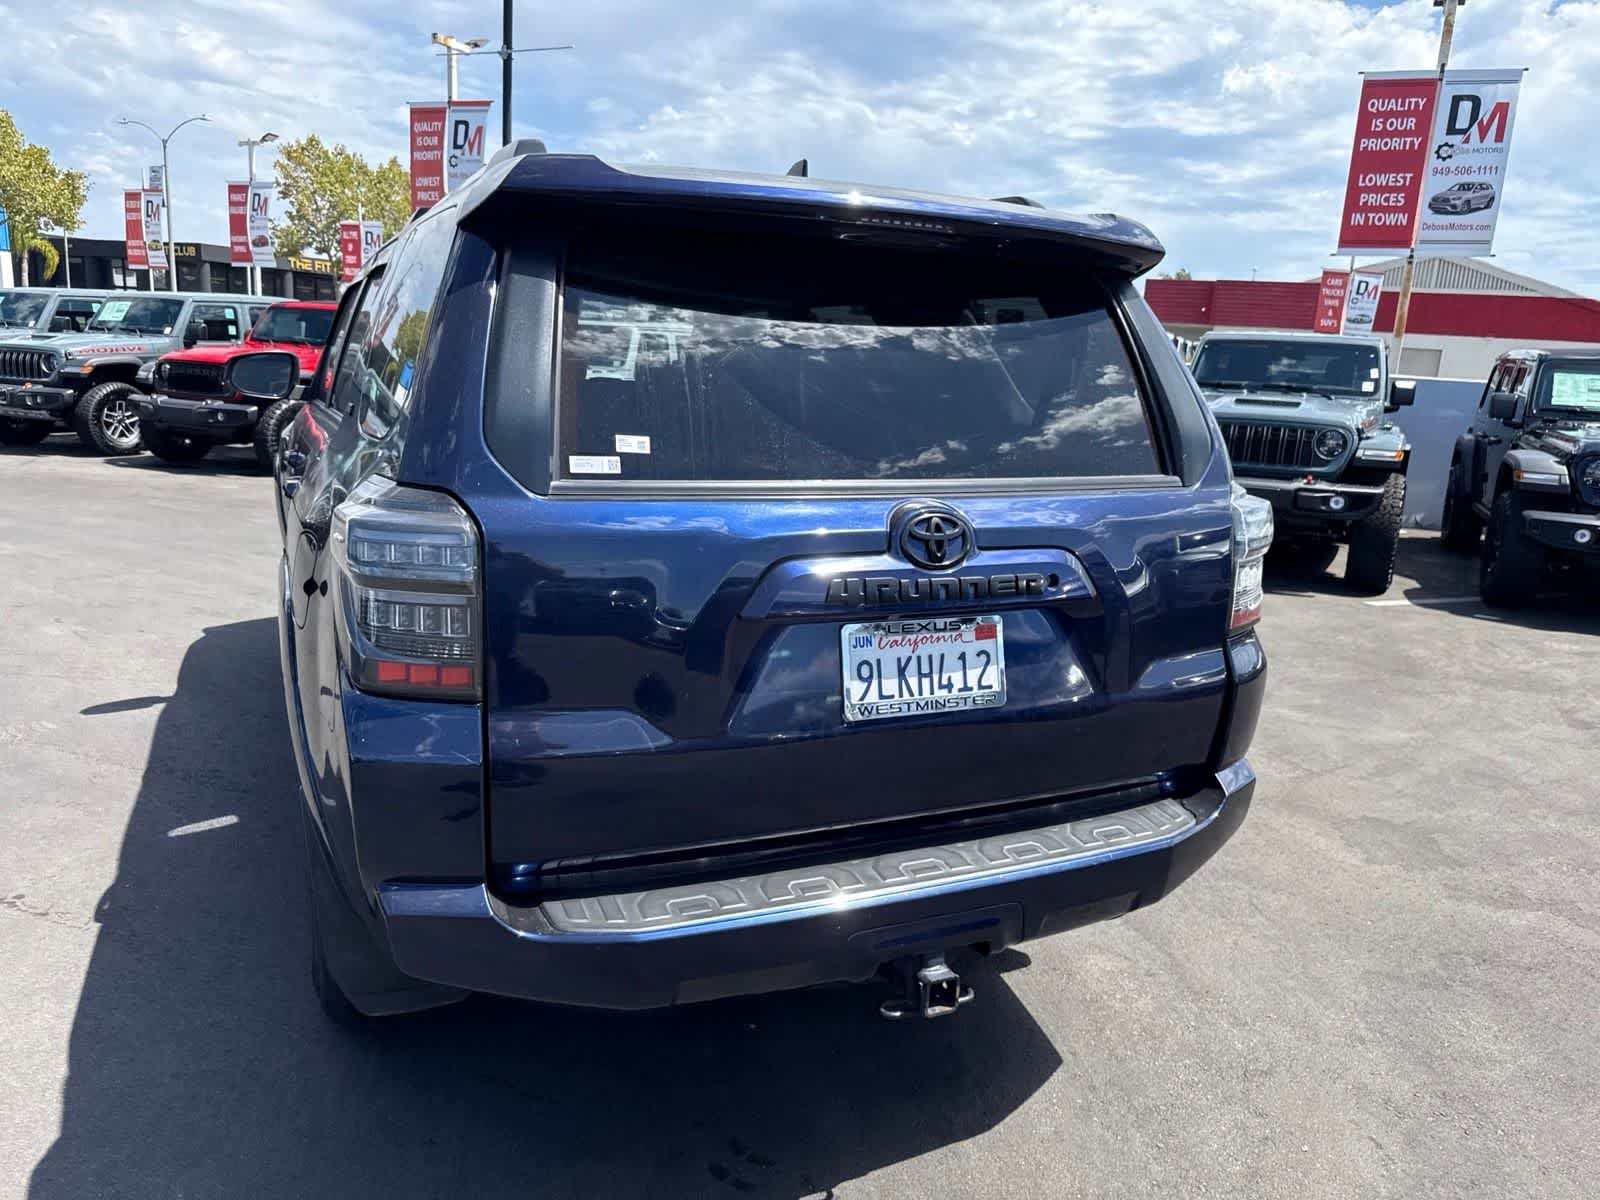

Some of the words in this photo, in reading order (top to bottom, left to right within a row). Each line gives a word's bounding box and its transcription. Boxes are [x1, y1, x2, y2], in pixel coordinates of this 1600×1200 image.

[1367, 97, 1427, 113] QUALITY
[414, 121, 442, 132] QUALITY
[1371, 118, 1384, 131] IS
[1386, 117, 1416, 131] OUR
[416, 136, 423, 146] IS
[424, 136, 439, 146] OUR
[1360, 137, 1422, 151] PRIORITY
[414, 151, 442, 161] PRIORITY
[1432, 165, 1499, 177] 949-506-1111
[415, 176, 440, 187] LOWEST
[1358, 173, 1413, 187] LOWEST
[417, 191, 440, 201] PRICES
[1359, 193, 1405, 206] PRICES
[1350, 213, 1365, 226] IN
[1367, 213, 1408, 226] TOWN
[288, 257, 313, 271] THE
[315, 260, 332, 273] FIT
[1326, 278, 1343, 286] CARS
[1322, 288, 1344, 297] TRUCKS
[79, 344, 146, 354] MOJAVE
[888, 620, 961, 634] LEXUS
[852, 635, 873, 649] JUN
[877, 632, 974, 654] California
[856, 649, 994, 702] 9LKH412
[857, 694, 997, 717] WESTMINSTER
